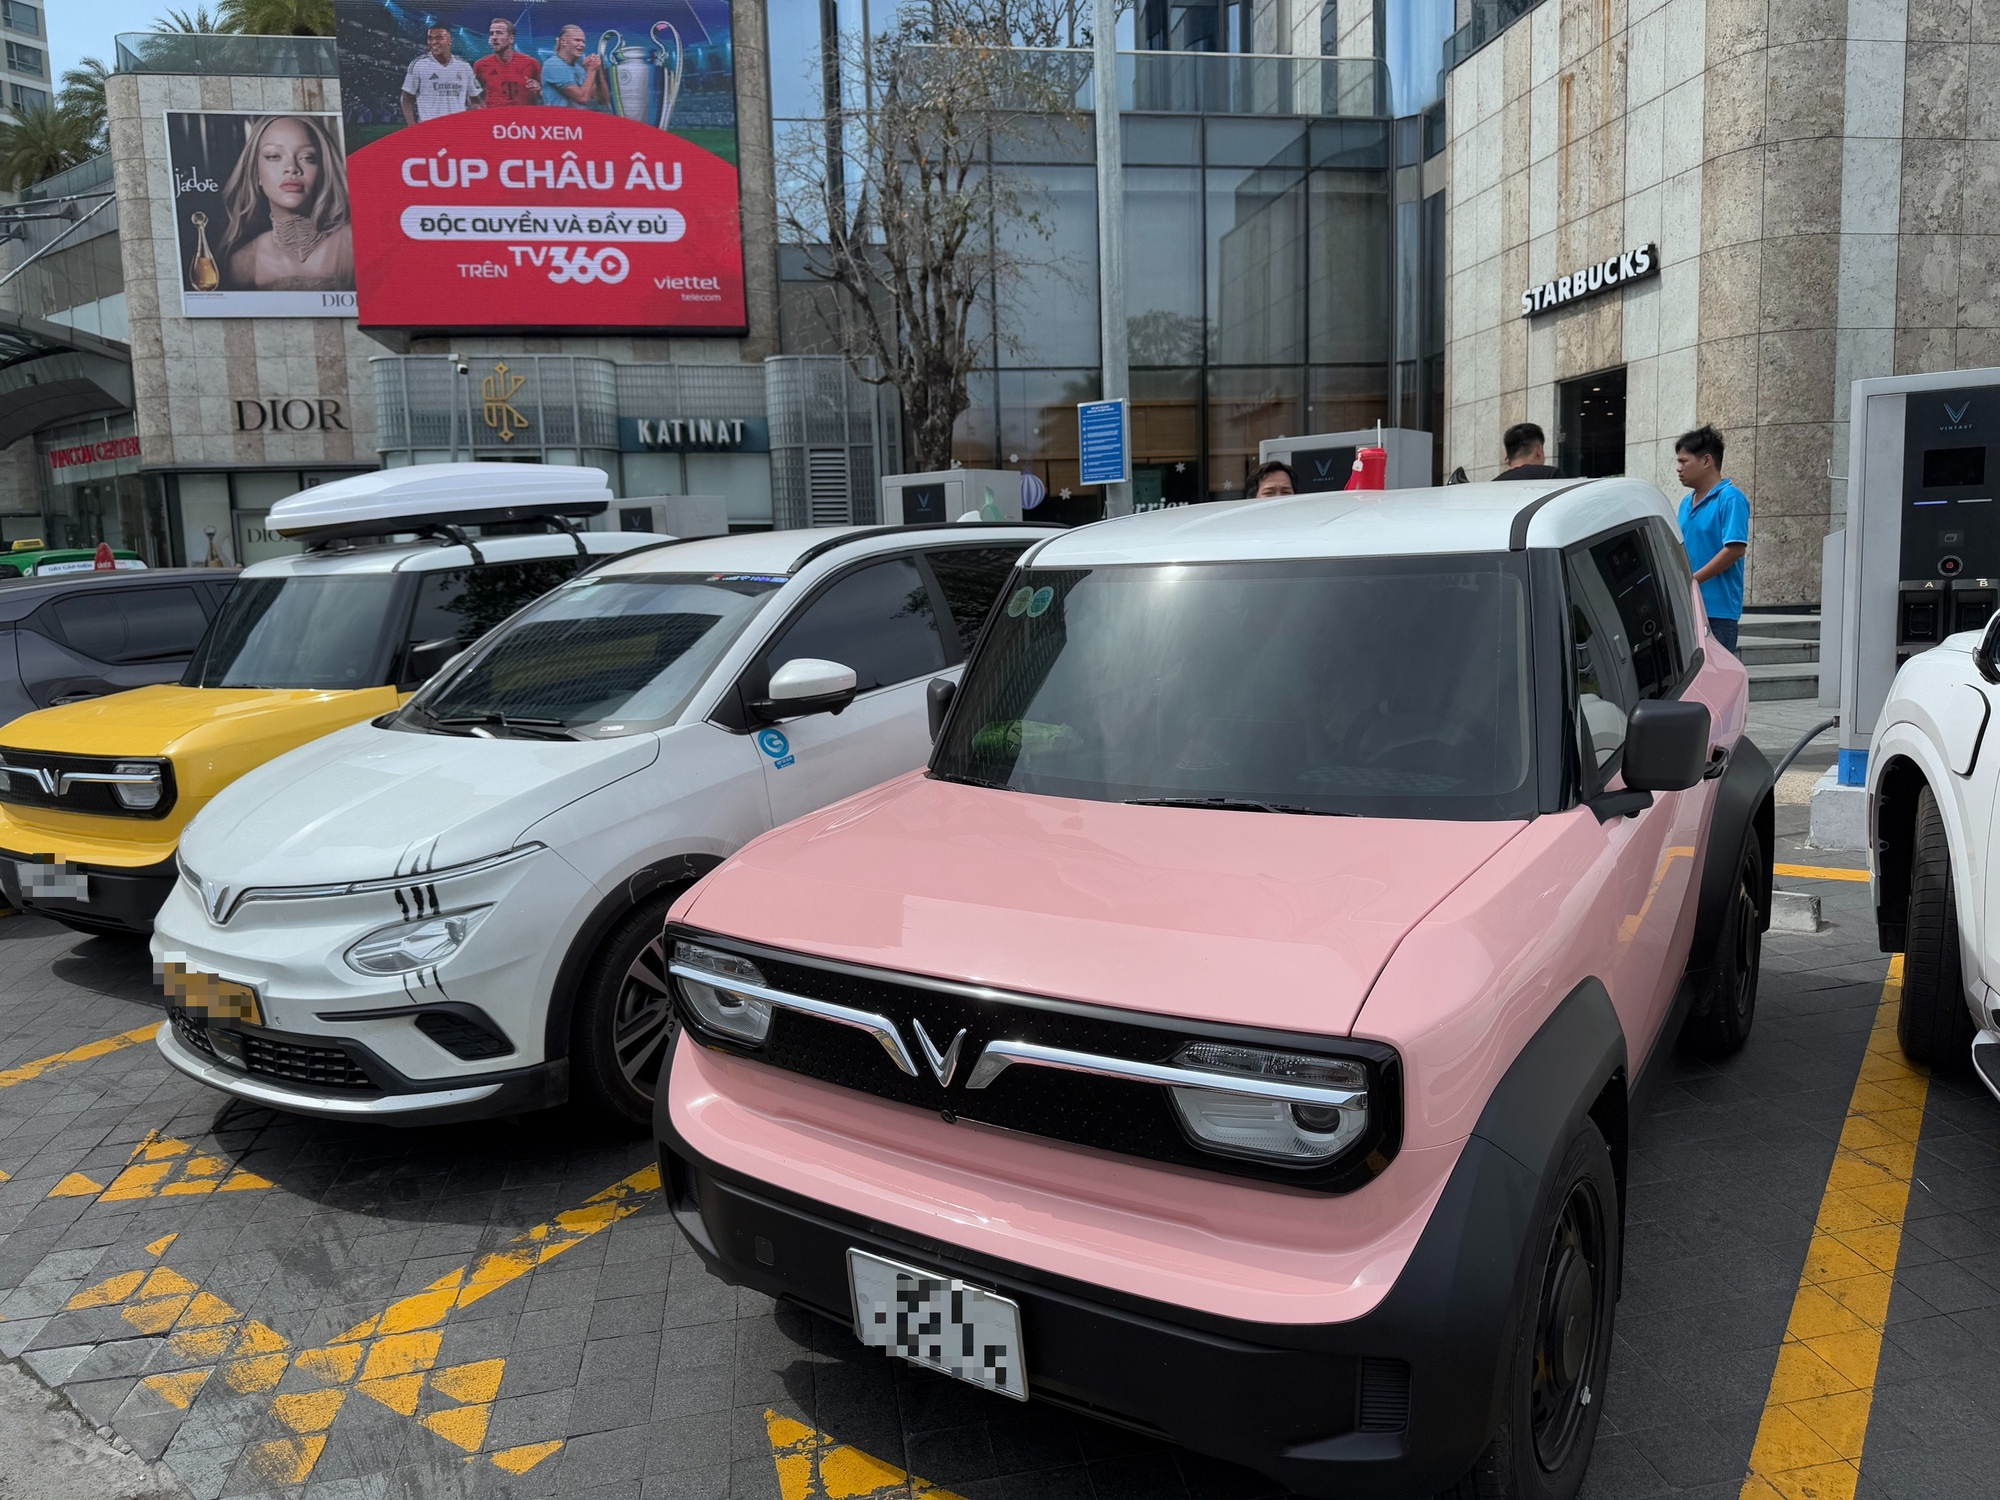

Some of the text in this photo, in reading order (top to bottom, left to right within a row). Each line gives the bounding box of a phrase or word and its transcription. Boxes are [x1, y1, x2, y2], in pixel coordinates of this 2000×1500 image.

[493, 122, 583, 140] ĐÓN XEM
[402, 148, 683, 191] CÚP CHÂU ÂU
[420, 210, 668, 235] ĐỘC QUYỀN VÀ ĐẦY ĐỦ
[457, 246, 630, 284] TRÊN TV360
[653, 276, 721, 290] viettel
[1521, 244, 1651, 315] STARBUCKS
[322, 294, 359, 307] DIO
[681, 293, 722, 302] telecom
[233, 398, 349, 431] DIOR
[637, 418, 745, 443] KATINAT
[246, 528, 289, 543] DIO
